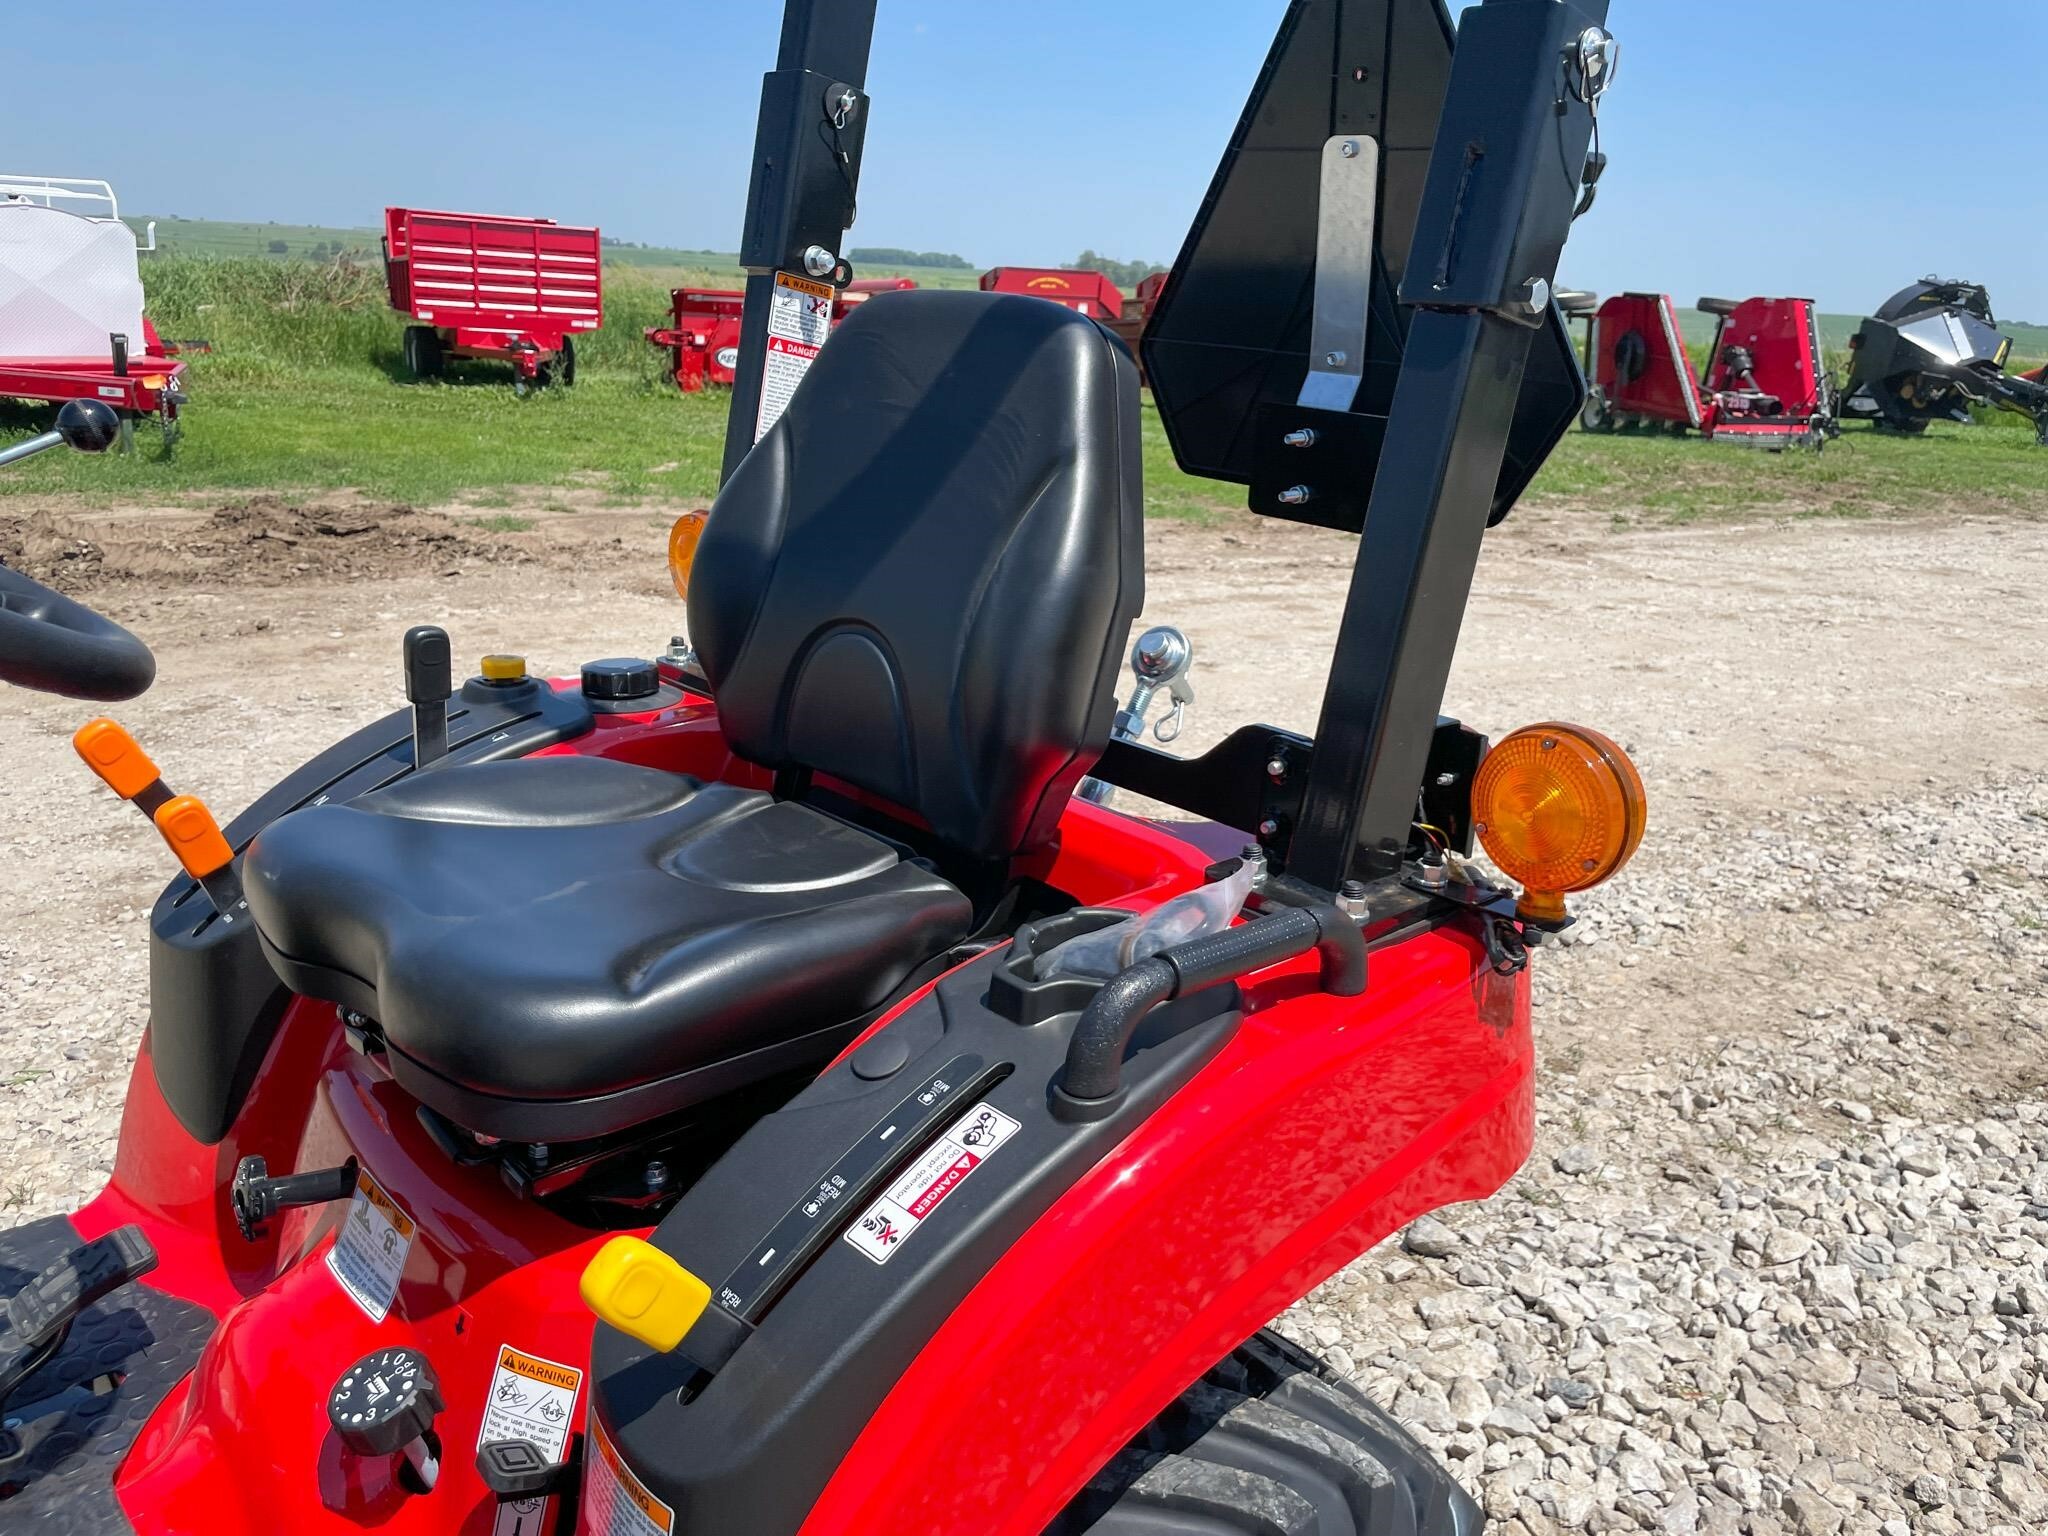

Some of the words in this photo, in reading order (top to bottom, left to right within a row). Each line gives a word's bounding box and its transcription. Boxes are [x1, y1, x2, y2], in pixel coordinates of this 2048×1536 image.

[793, 280, 829, 297] WARNING
[933, 1079, 950, 1093] MID
[928, 1144, 952, 1168] except
[948, 1149, 961, 1159] Do
[934, 1160, 947, 1173] not
[820, 1180, 841, 1199] REAR
[831, 1174, 847, 1189] MID
[896, 1169, 926, 1200] operator
[918, 1174, 933, 1189] ride
[913, 1170, 960, 1214] DANGER
[721, 1286, 742, 1308] REAR
[518, 1359, 575, 1386] WARNING
[335, 1391, 351, 1402] 2
[365, 1407, 377, 1421] 3
[490, 1409, 509, 1421] Never
[511, 1418, 523, 1427] use
[525, 1422, 536, 1431] the
[489, 1418, 501, 1427] lock
[512, 1428, 527, 1437] high
[530, 1433, 551, 1445] speed
